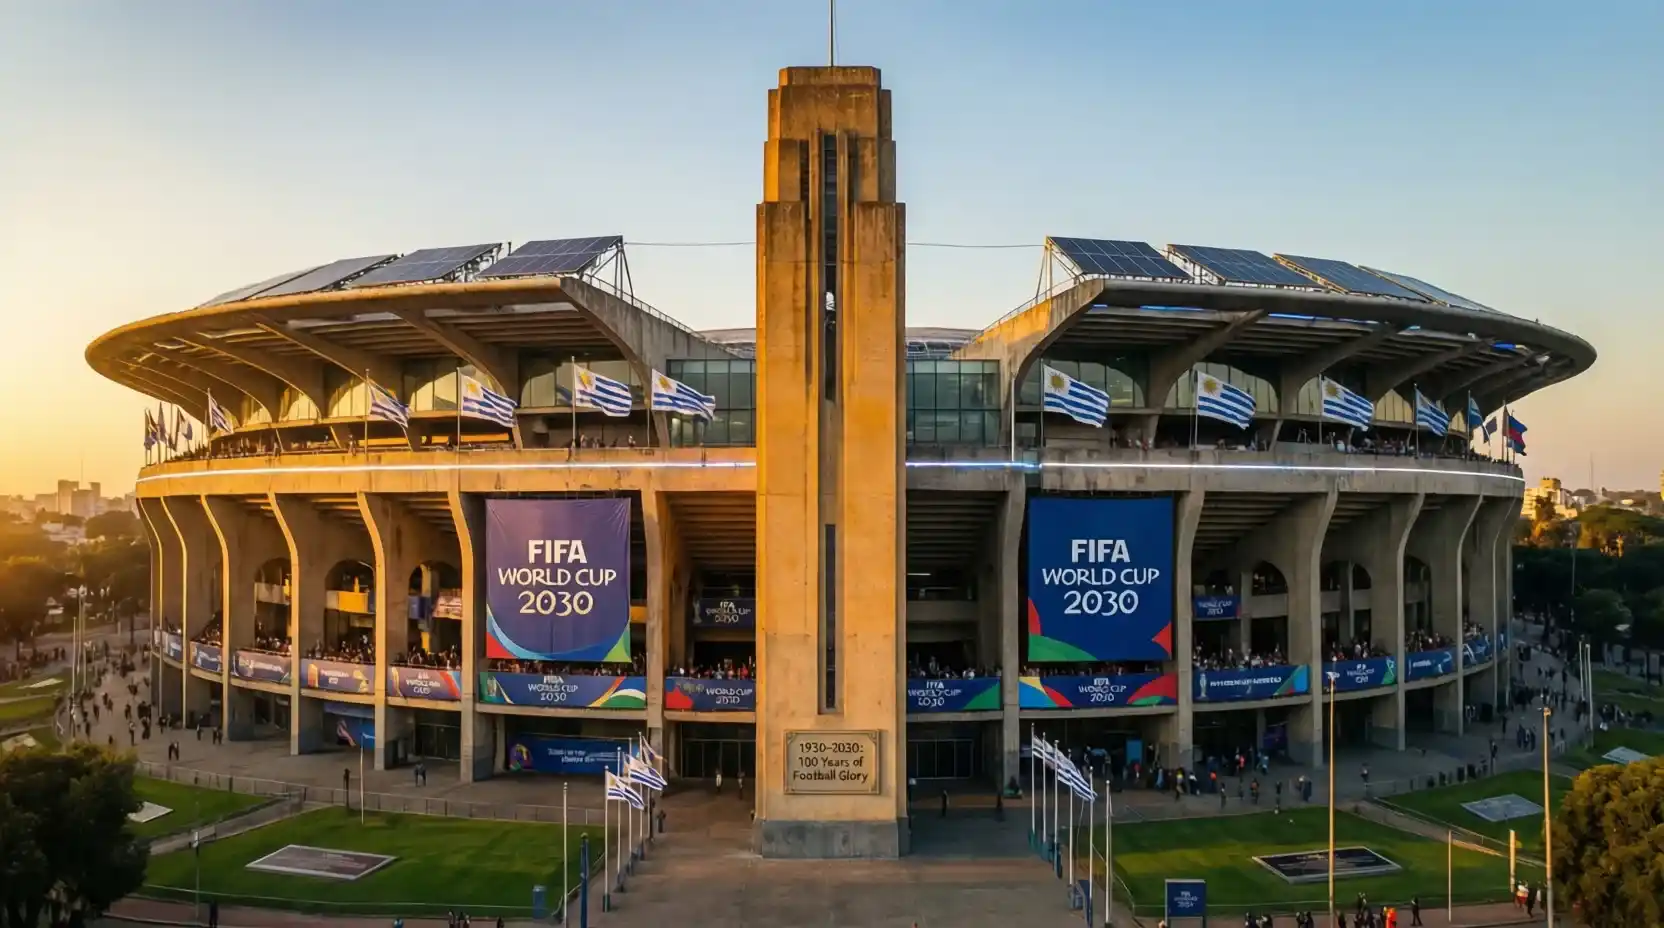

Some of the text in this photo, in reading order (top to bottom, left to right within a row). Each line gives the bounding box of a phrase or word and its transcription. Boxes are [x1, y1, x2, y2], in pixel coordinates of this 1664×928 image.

[528, 539, 588, 564] FIFA
[1071, 539, 1130, 563] FIFA
[498, 568, 617, 587] WORLD CUP
[1042, 567, 1160, 586] WORLD CUP
[518, 590, 594, 617] 2030
[1063, 590, 1139, 617] 2030
[798, 756, 864, 768] 100 Years of
[793, 769, 868, 783] Football Glory
